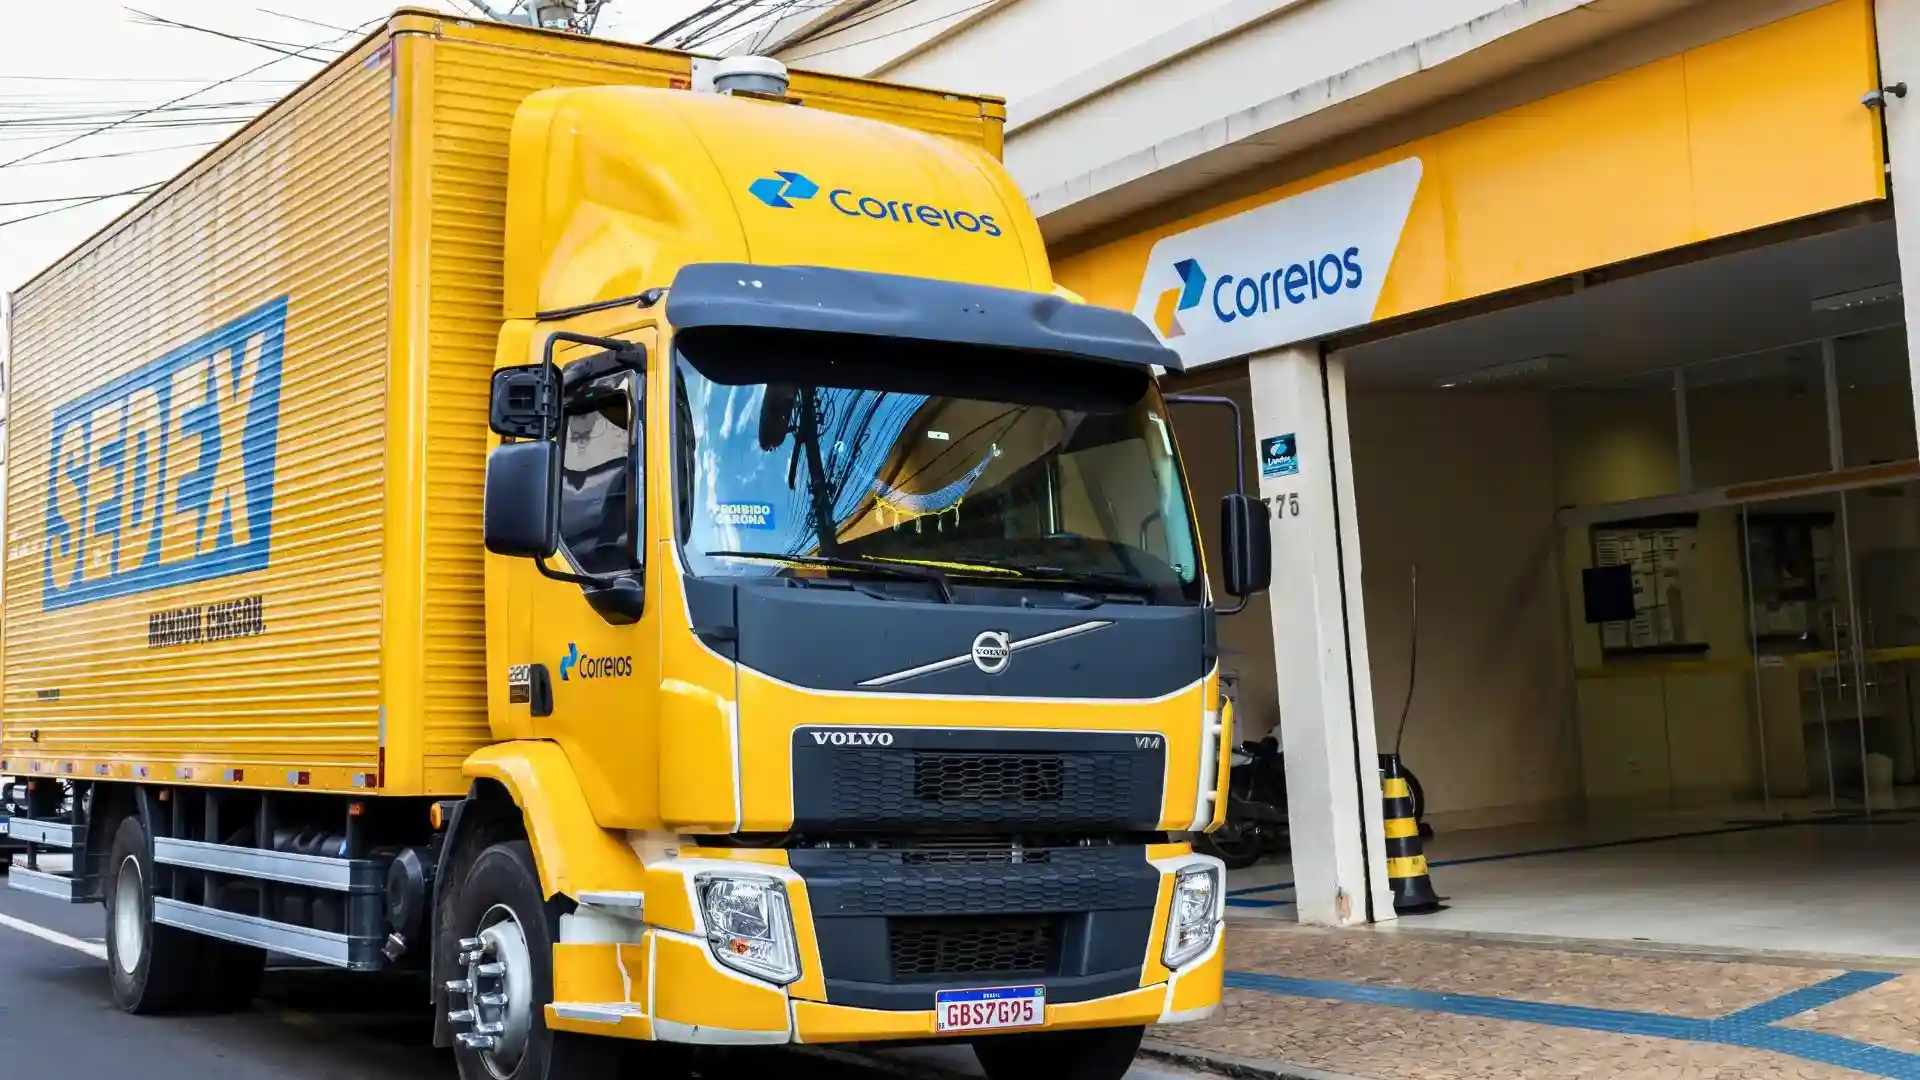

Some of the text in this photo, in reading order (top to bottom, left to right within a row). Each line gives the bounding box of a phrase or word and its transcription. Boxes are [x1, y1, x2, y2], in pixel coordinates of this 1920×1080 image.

[829, 189, 1002, 237] Correios
[1212, 246, 1363, 323] Correios
[51, 332, 265, 591] SEDEX
[148, 604, 204, 648] MANDOU,
[579, 653, 632, 678] Correios
[975, 648, 1008, 657] VOLVO
[810, 731, 894, 746] VOLVO
[1134, 736, 1160, 749] VM
[947, 1000, 1033, 1026] GBS7G95
